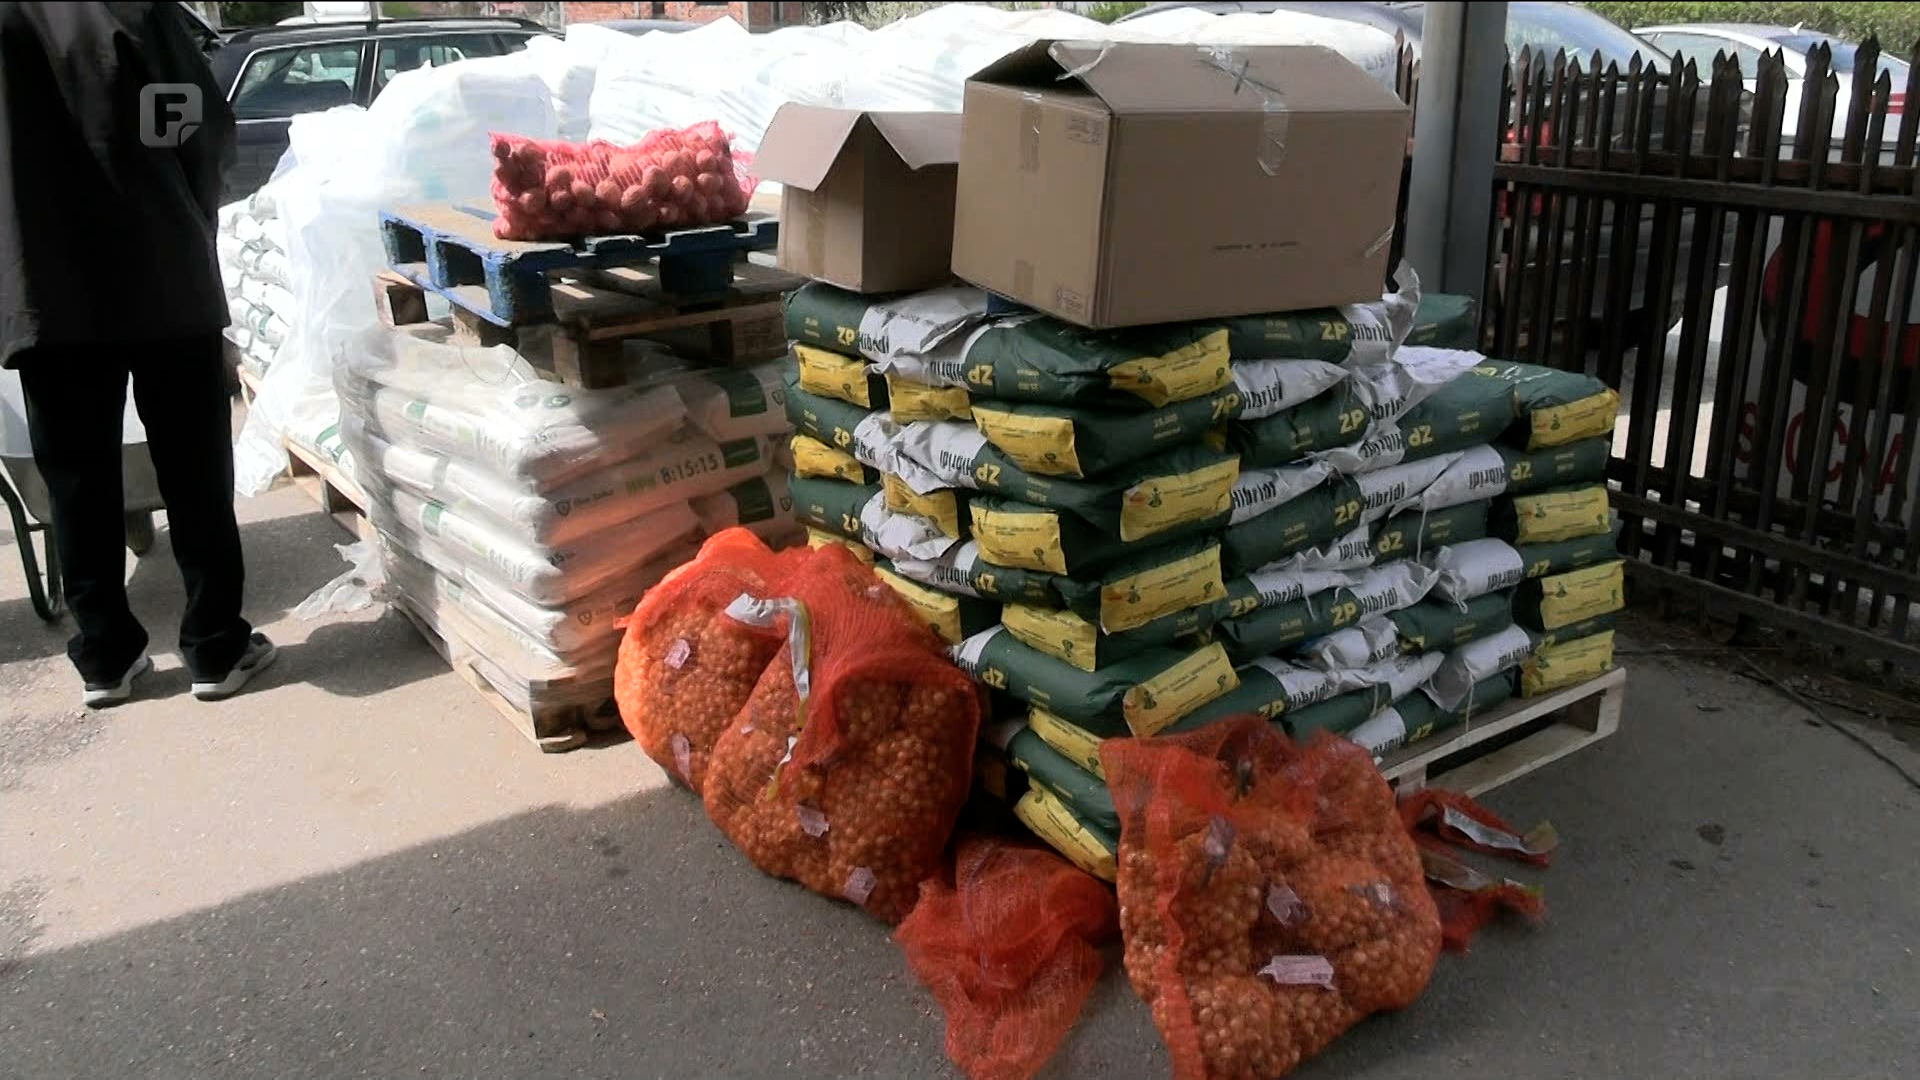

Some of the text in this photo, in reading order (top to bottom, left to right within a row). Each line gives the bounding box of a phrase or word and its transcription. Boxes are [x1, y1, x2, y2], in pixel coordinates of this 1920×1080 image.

[836, 325, 856, 346] ZP
[1319, 321, 1348, 340] ZP
[967, 364, 993, 385] ZP
[1338, 409, 1365, 434] ZP
[833, 426, 851, 447] ZP
[1408, 425, 1433, 446] ZP
[976, 463, 1001, 486] ZP
[1510, 461, 1533, 481] ZP
[1334, 500, 1361, 526] ZP
[1378, 531, 1404, 553] ZP
[1230, 596, 1259, 617] ZP
[1330, 602, 1358, 626] ZP
